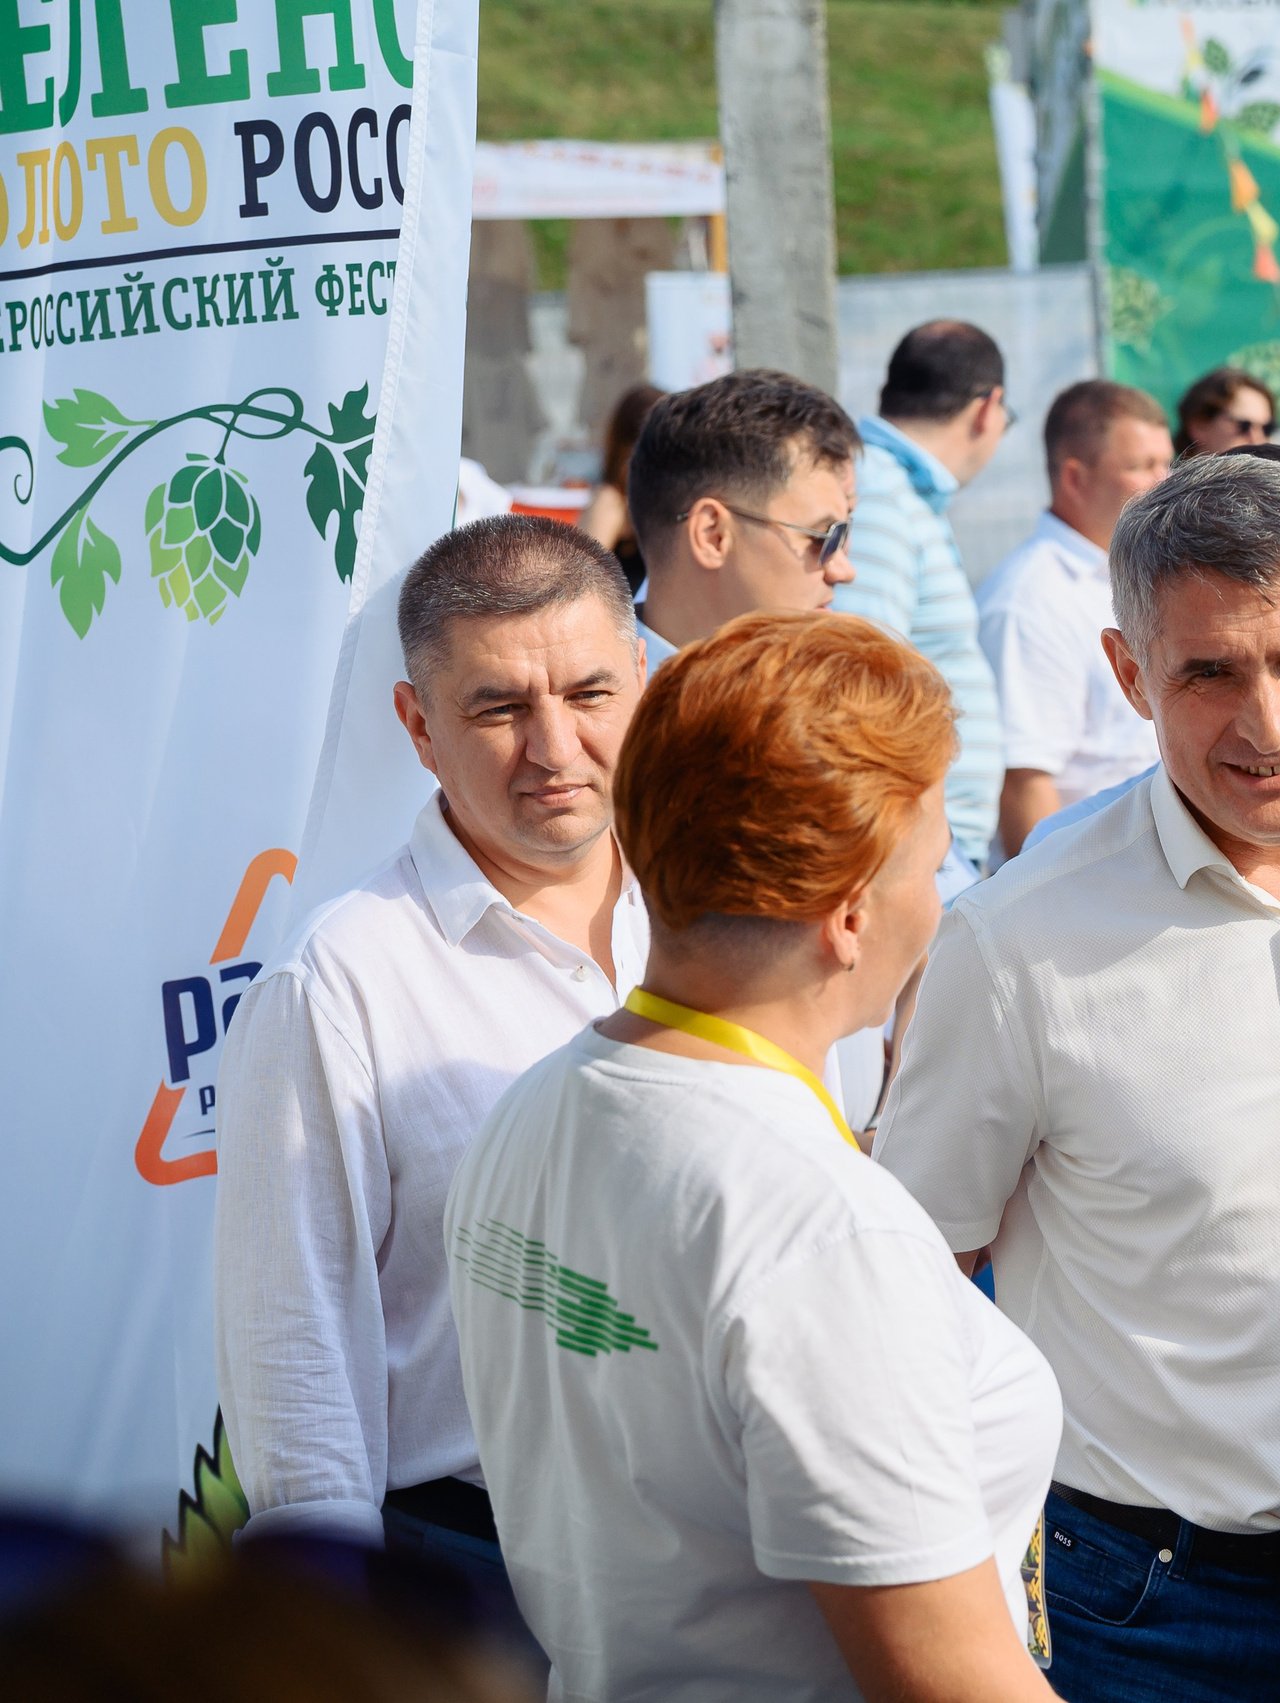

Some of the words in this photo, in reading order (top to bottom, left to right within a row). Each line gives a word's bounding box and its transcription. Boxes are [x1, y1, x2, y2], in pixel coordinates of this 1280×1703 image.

[0, 127, 207, 249] ЛОТО
[0, 257, 299, 353] РОССИЙСКИЙ
[1054, 1531, 1072, 1548] BOSS
